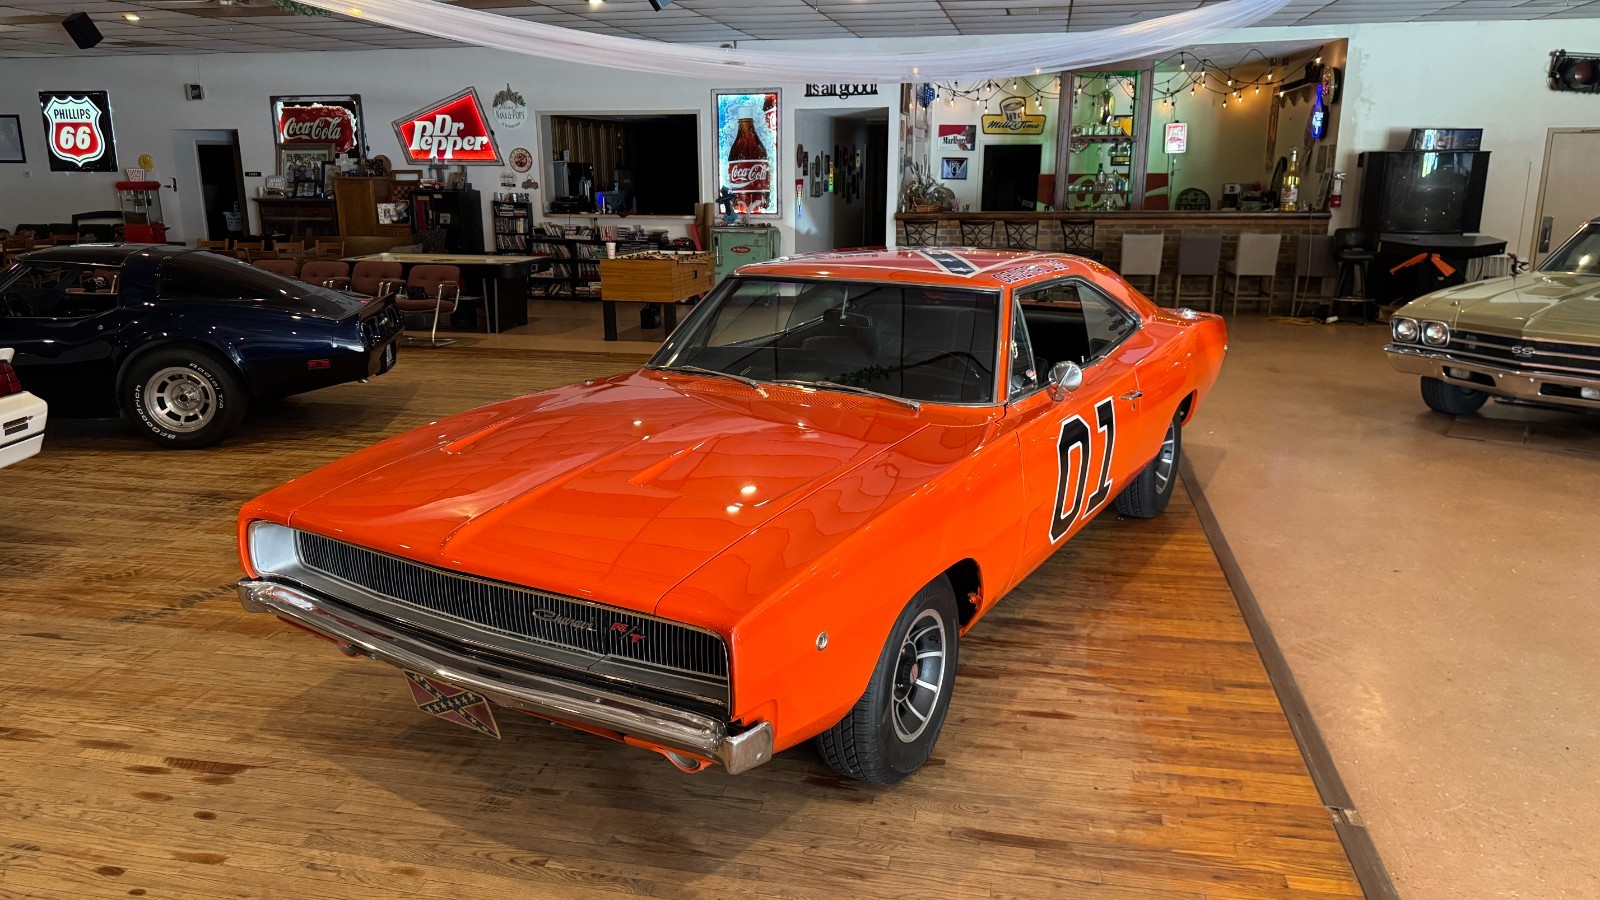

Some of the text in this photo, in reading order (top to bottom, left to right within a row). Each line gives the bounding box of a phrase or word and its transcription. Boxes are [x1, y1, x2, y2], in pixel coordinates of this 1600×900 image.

[821, 83, 837, 96] all
[54, 108, 91, 120] PHILLIPS
[1018, 120, 1041, 129] Time
[283, 116, 343, 140] Coca-Cola
[433, 114, 464, 137] Dr
[60, 125, 91, 150] 66
[409, 120, 489, 159] Pepper
[731, 163, 769, 182] Coca-Cola
[1511, 345, 1535, 356] SS
[189, 362, 221, 390] Radial
[1048, 397, 1117, 545] 01
[610, 622, 647, 644] R/T
